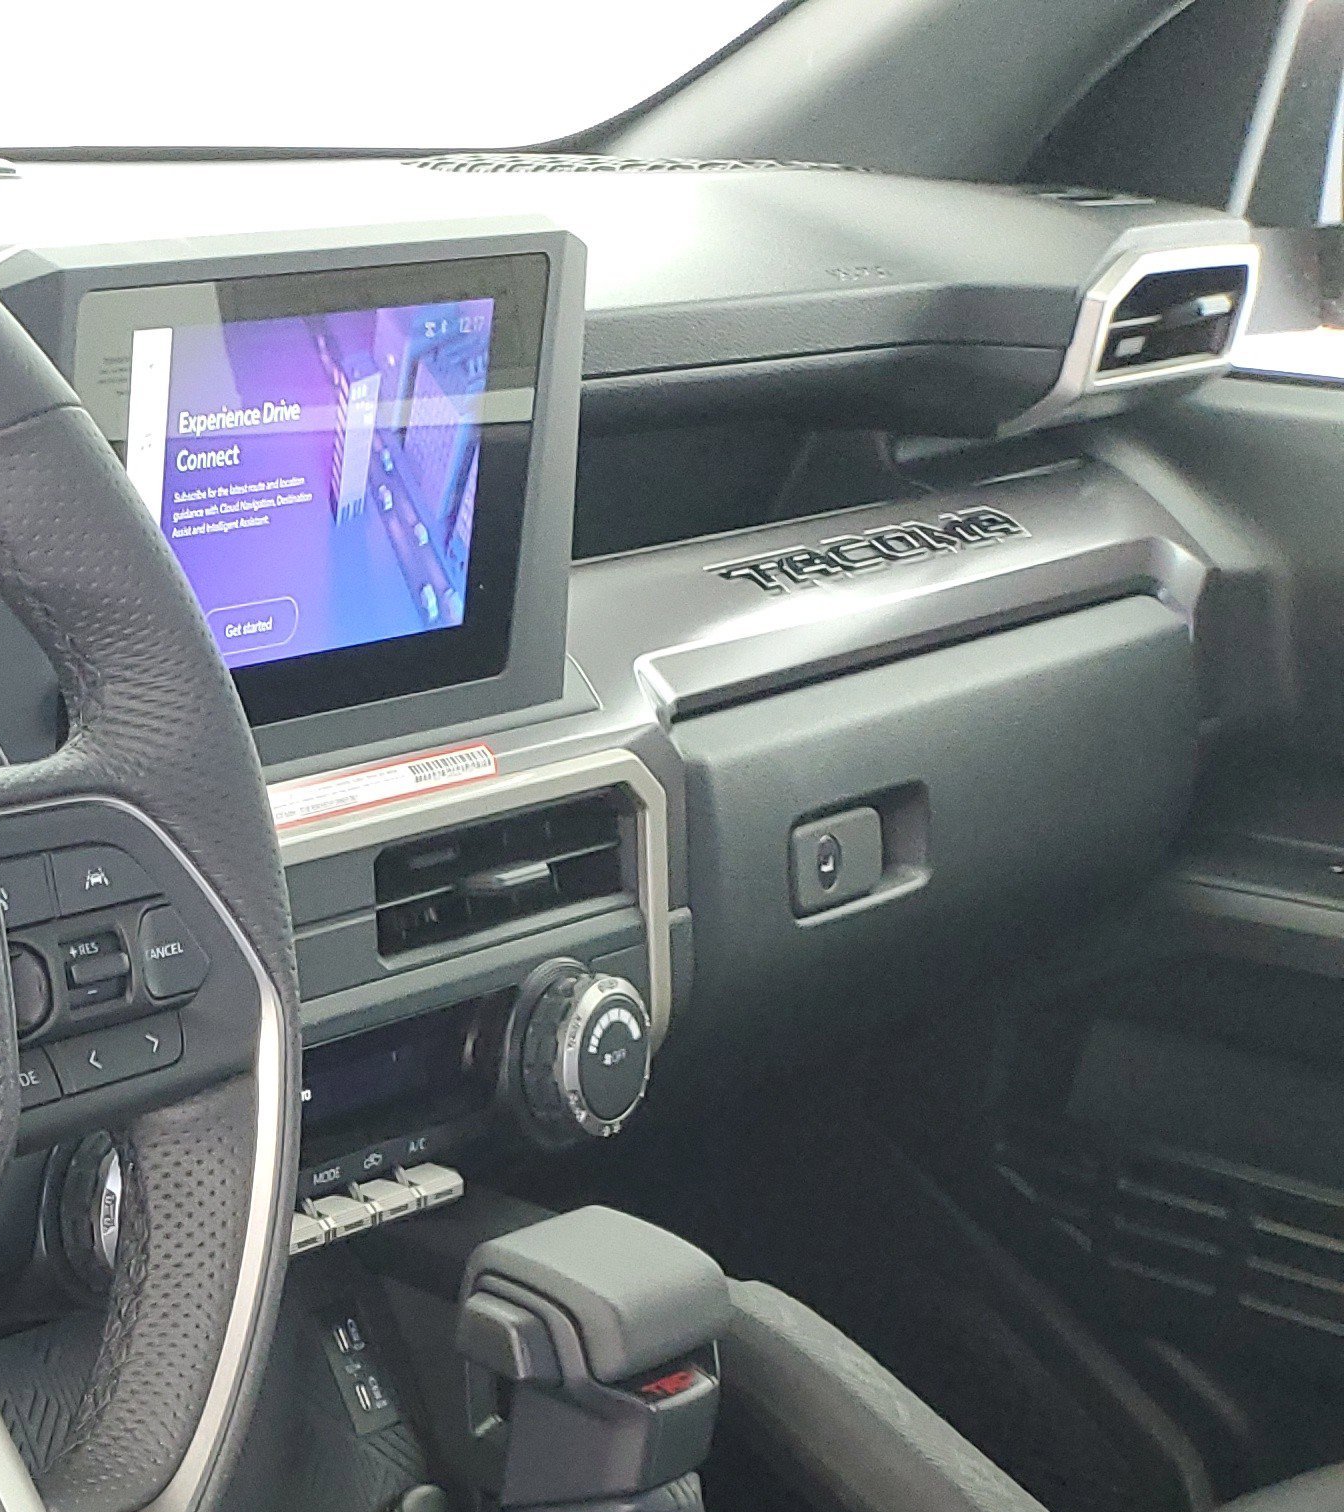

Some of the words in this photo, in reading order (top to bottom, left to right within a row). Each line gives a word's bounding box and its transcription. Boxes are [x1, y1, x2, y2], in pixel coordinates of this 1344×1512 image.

[179, 405, 261, 436] Experience
[262, 399, 301, 424] Drive
[176, 444, 240, 472] Connect
[703, 505, 1033, 594] TACOMA
[225, 624, 242, 638] Get
[242, 616, 273, 635] started
[313, 1166, 340, 1186] MODE
